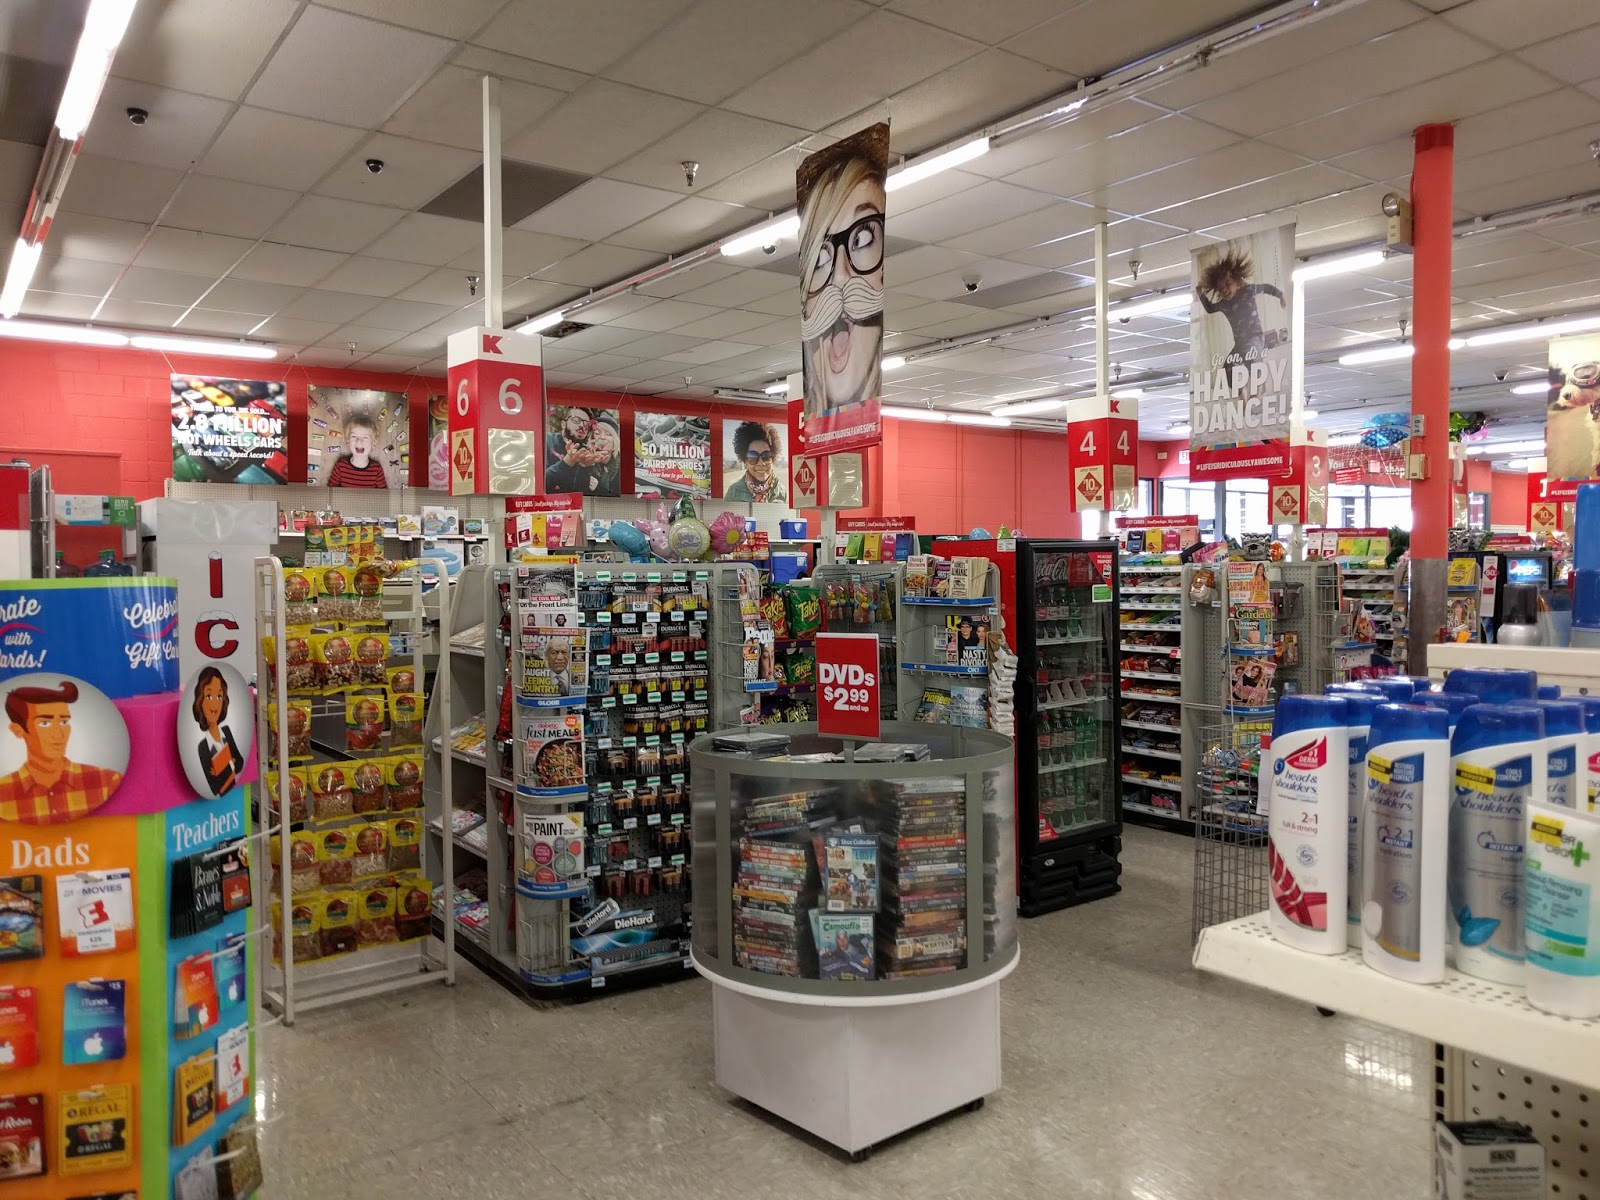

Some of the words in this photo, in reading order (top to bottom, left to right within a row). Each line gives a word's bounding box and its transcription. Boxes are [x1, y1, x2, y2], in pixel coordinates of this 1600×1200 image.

[482, 335, 503, 354] K
[1212, 353, 1225, 371] Go
[1226, 352, 1243, 366] on,
[1245, 348, 1259, 362] do
[1260, 348, 1269, 358] a
[1193, 358, 1287, 403] HAPPY
[456, 379, 470, 416] 6
[498, 378, 523, 415] 6
[1110, 400, 1120, 413] K
[1193, 393, 1287, 435] DANCE!
[178, 413, 209, 431] 2.8
[213, 414, 282, 434] MILLION
[203, 435, 252, 447] WHEELS
[253, 437, 282, 448] CARS
[1080, 431, 1097, 457] 4
[1117, 430, 1130, 456] 4
[641, 443, 657, 456] 50
[660, 444, 705, 459] MILLION
[643, 459, 665, 469] PAIRS
[667, 461, 677, 469] OF
[678, 461, 703, 471] SHOES
[1196, 456, 1284, 471] #LIFEISRIDICULOUSLYAWESOME
[1312, 455, 1321, 478] 3
[1517, 565, 1542, 576] PEPSI
[760, 598, 784, 619] Takis
[1236, 609, 1271, 619] Gardens
[5, 632, 33, 646] with
[744, 626, 774, 647] People
[125, 642, 161, 669] Gift
[963, 650, 987, 659] NASTY
[960, 659, 988, 667] DIVORC
[819, 664, 875, 687] DVDs
[861, 705, 869, 713] up
[525, 725, 547, 740] fast
[548, 728, 580, 738] MEALS
[1299, 756, 1318, 764] DERM
[1284, 769, 1309, 783] head
[1310, 775, 1318, 783] &
[1460, 770, 1488, 783] REDUCED
[1497, 774, 1522, 782] CONTACT
[1505, 768, 1522, 776] COOLS
[1275, 778, 1318, 794] shoulders
[1379, 784, 1405, 799] head
[1405, 791, 1414, 800] &
[1369, 794, 1413, 812] shoulders
[1460, 798, 1522, 814] shoulders
[1512, 794, 1522, 803] &
[172, 810, 240, 852] Teachers
[534, 822, 564, 836] PAINT
[1283, 820, 1291, 828] full
[1297, 824, 1318, 834] strong
[1385, 837, 1409, 848] INSTANT
[1488, 843, 1519, 852] INSTANT
[11, 838, 90, 869] Dads
[855, 849, 874, 860] LOST
[194, 866, 221, 889] Barnes
[82, 884, 122, 896] MOVIES
[585, 904, 612, 928] DieHard
[615, 914, 653, 930] DieHard
[82, 998, 110, 1007] iTunes
[80, 1103, 119, 1117] REGAL
